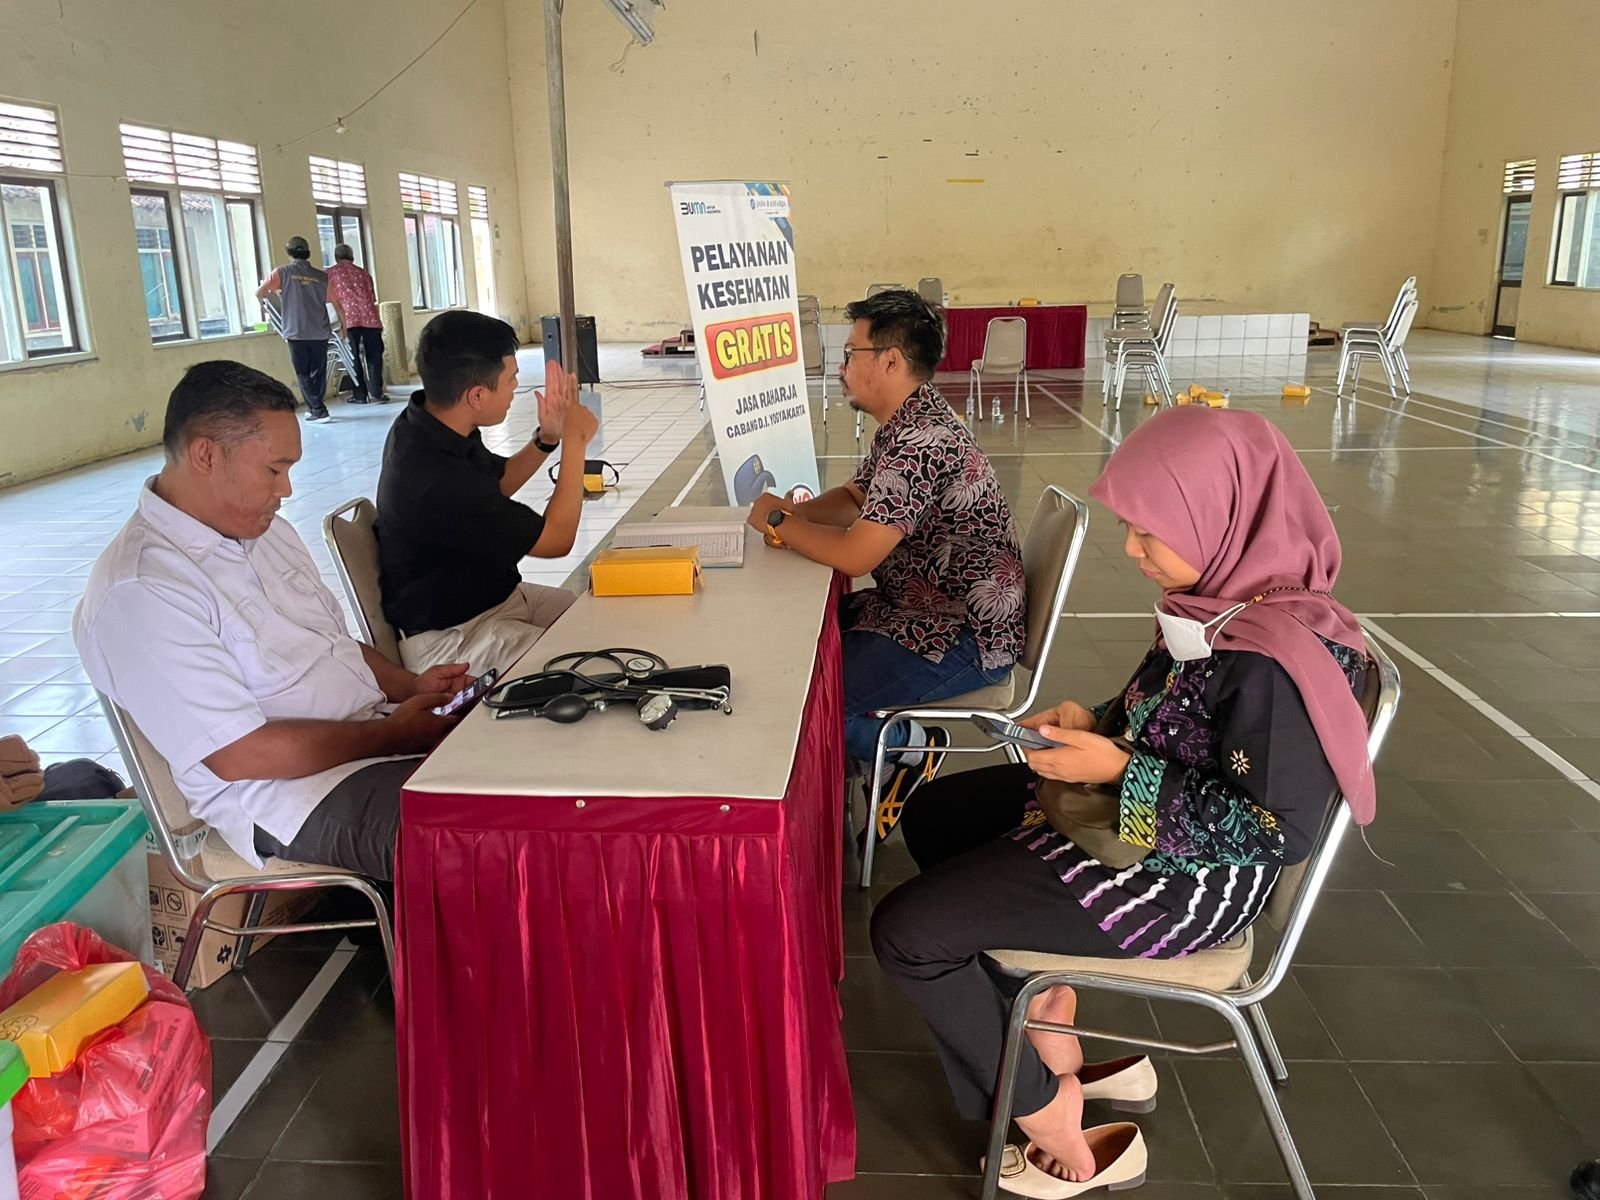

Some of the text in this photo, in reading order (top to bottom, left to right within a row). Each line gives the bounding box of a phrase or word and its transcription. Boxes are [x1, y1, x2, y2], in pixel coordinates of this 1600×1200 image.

[690, 240, 788, 272] PELAYANAN
[697, 275, 790, 310] KESEHATAN
[715, 320, 793, 370] GRATIS
[735, 384, 798, 415] JASA RAHARJA
[726, 420, 758, 438] CABANG
[770, 404, 806, 426] YOGYAKARTA
